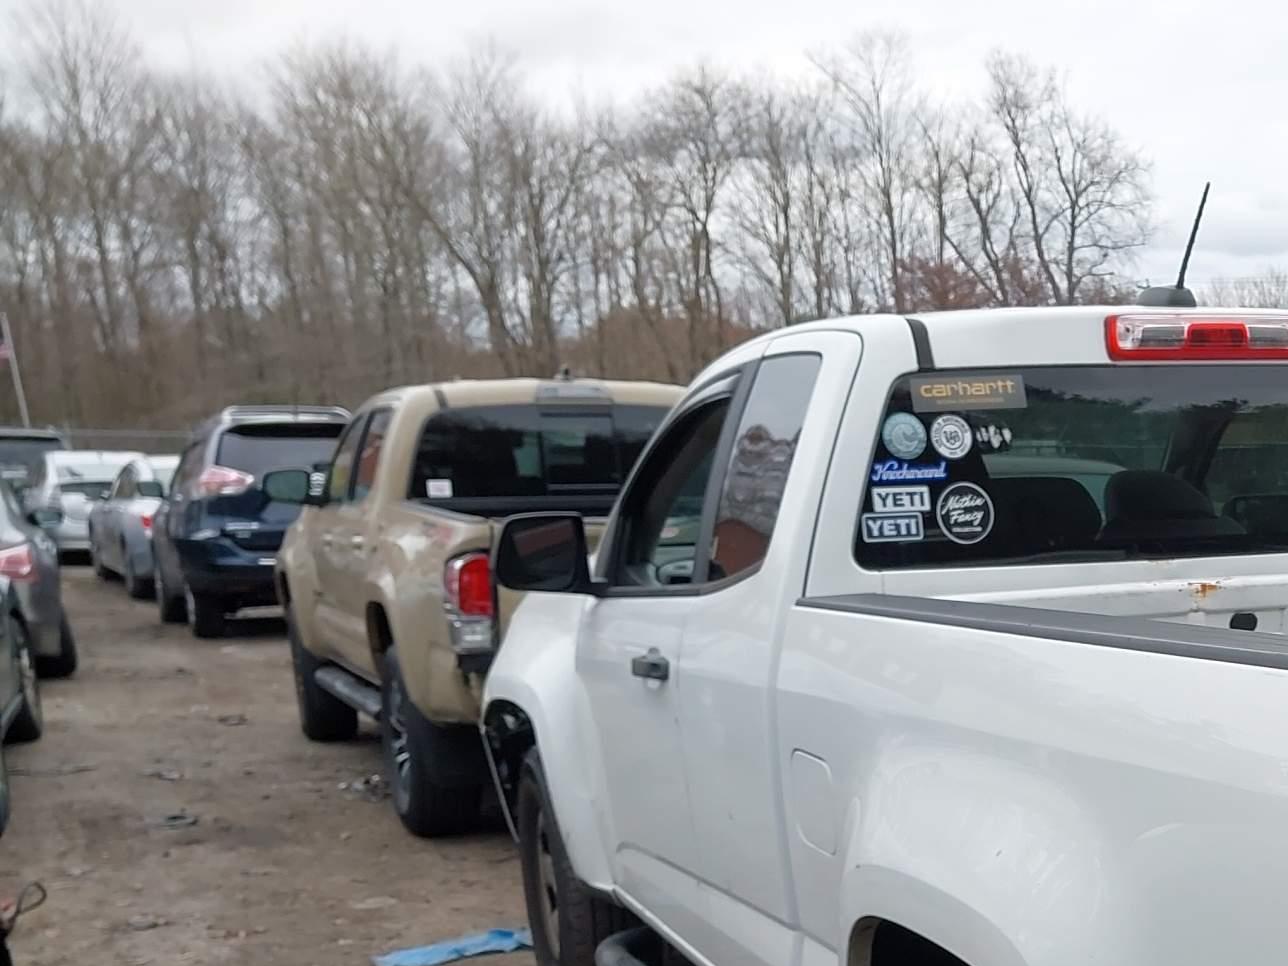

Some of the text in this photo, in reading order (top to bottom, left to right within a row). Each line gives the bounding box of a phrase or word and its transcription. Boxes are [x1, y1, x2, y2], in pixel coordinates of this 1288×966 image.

[920, 379, 1015, 398] carhartt
[876, 491, 925, 508] YETI
[950, 510, 985, 526] Fancy
[867, 518, 918, 537] YETI
